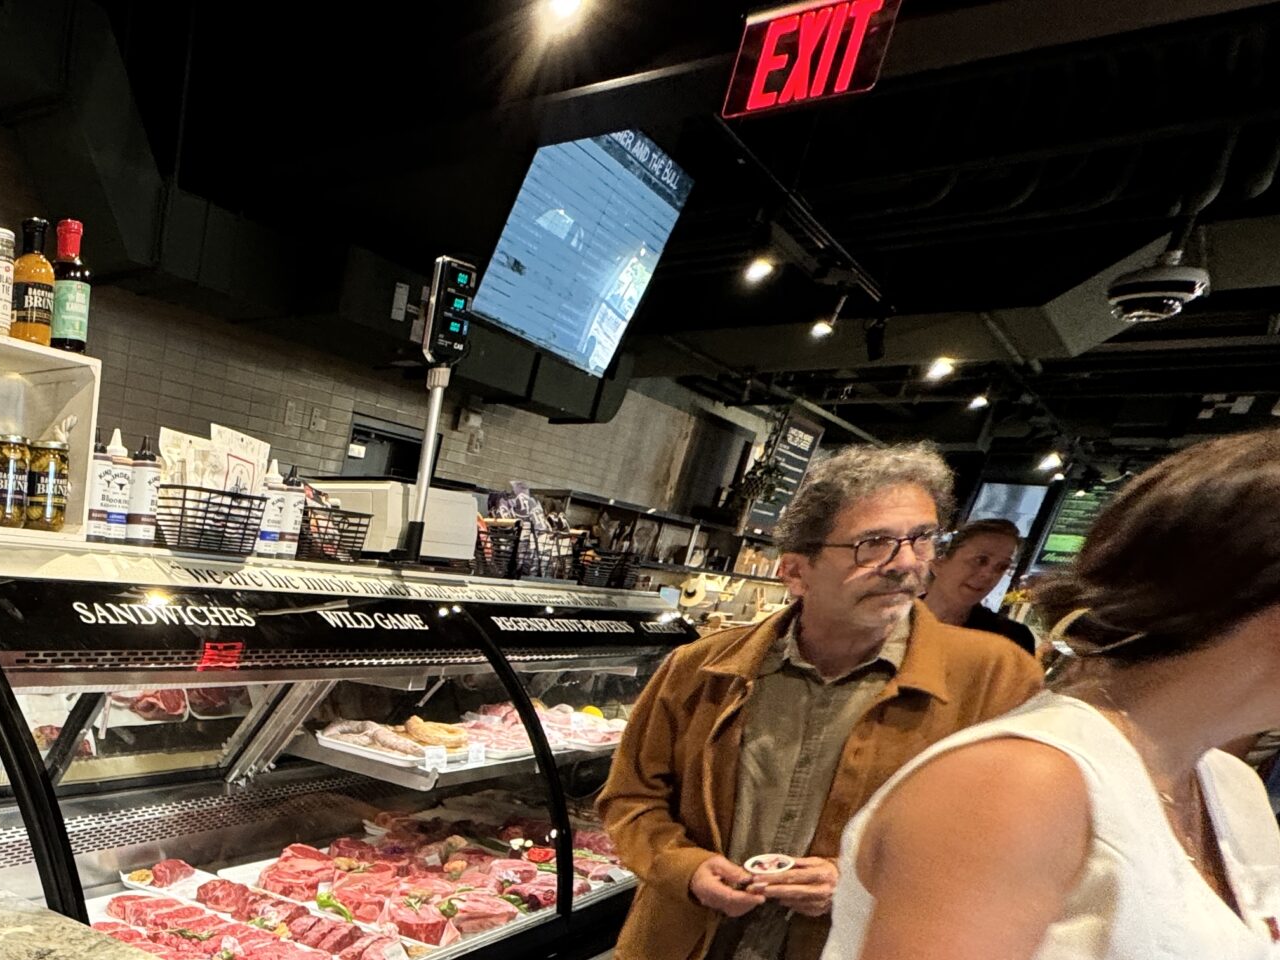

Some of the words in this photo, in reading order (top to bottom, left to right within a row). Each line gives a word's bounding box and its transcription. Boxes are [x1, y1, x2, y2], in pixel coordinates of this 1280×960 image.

[746, 0, 884, 110] EXIT
[648, 153, 665, 175] THE
[661, 160, 680, 190] BULL
[24, 295, 54, 312] BRIN
[225, 568, 263, 587] are
[261, 569, 300, 590] the
[299, 574, 359, 594] music
[72, 601, 257, 628] SANDWICHES
[316, 610, 375, 629] WILD
[373, 612, 429, 630] GAME
[491, 616, 588, 633] REGENERATIVE
